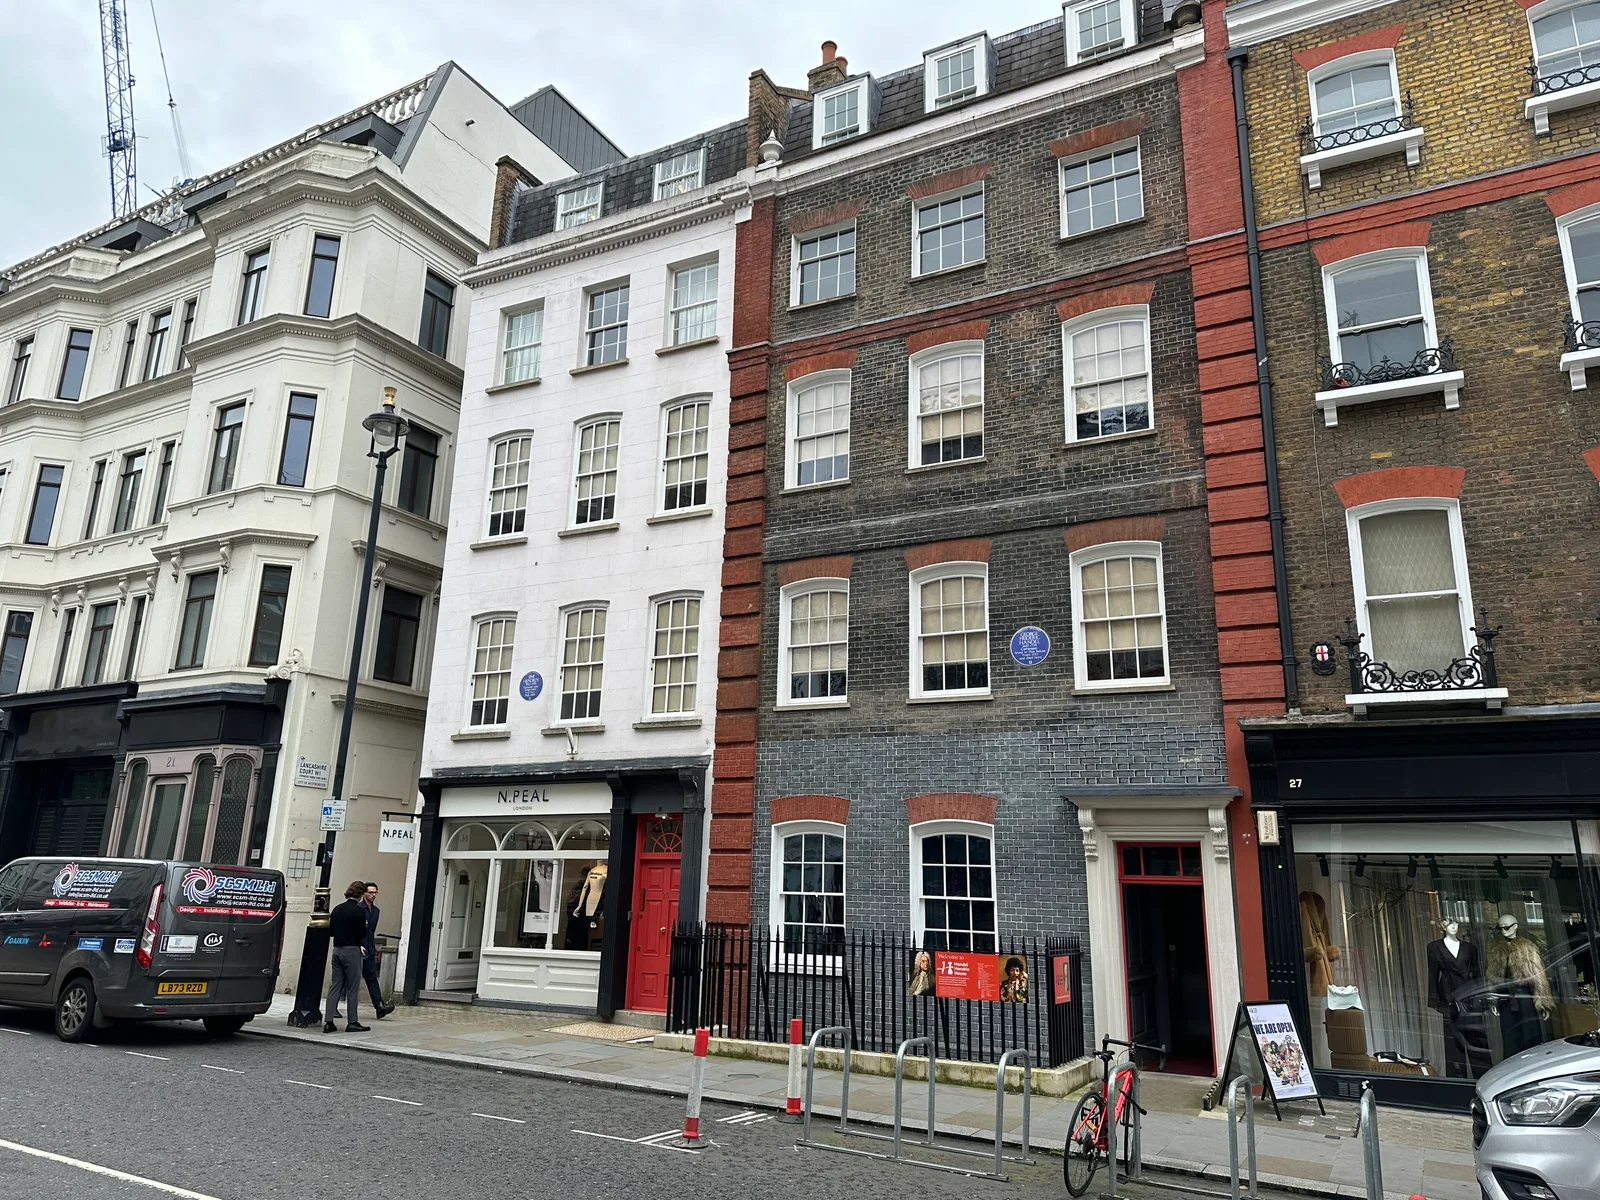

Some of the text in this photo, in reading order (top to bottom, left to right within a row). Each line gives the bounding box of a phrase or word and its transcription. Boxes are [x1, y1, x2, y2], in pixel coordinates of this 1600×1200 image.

[166, 757, 175, 767] 21
[300, 762, 327, 771] LANCASHIRE
[1289, 779, 1302, 788] 27
[498, 789, 549, 803] N.PEAL
[383, 829, 413, 839] N.PEAL
[216, 877, 276, 893] SCSM Ltd
[216, 894, 272, 902] www.scsm-ltd.co.uk
[204, 933, 223, 947] CHAS
[161, 984, 203, 992] LB73 RZD
[1253, 1022, 1294, 1035] WE ARE OPEN
